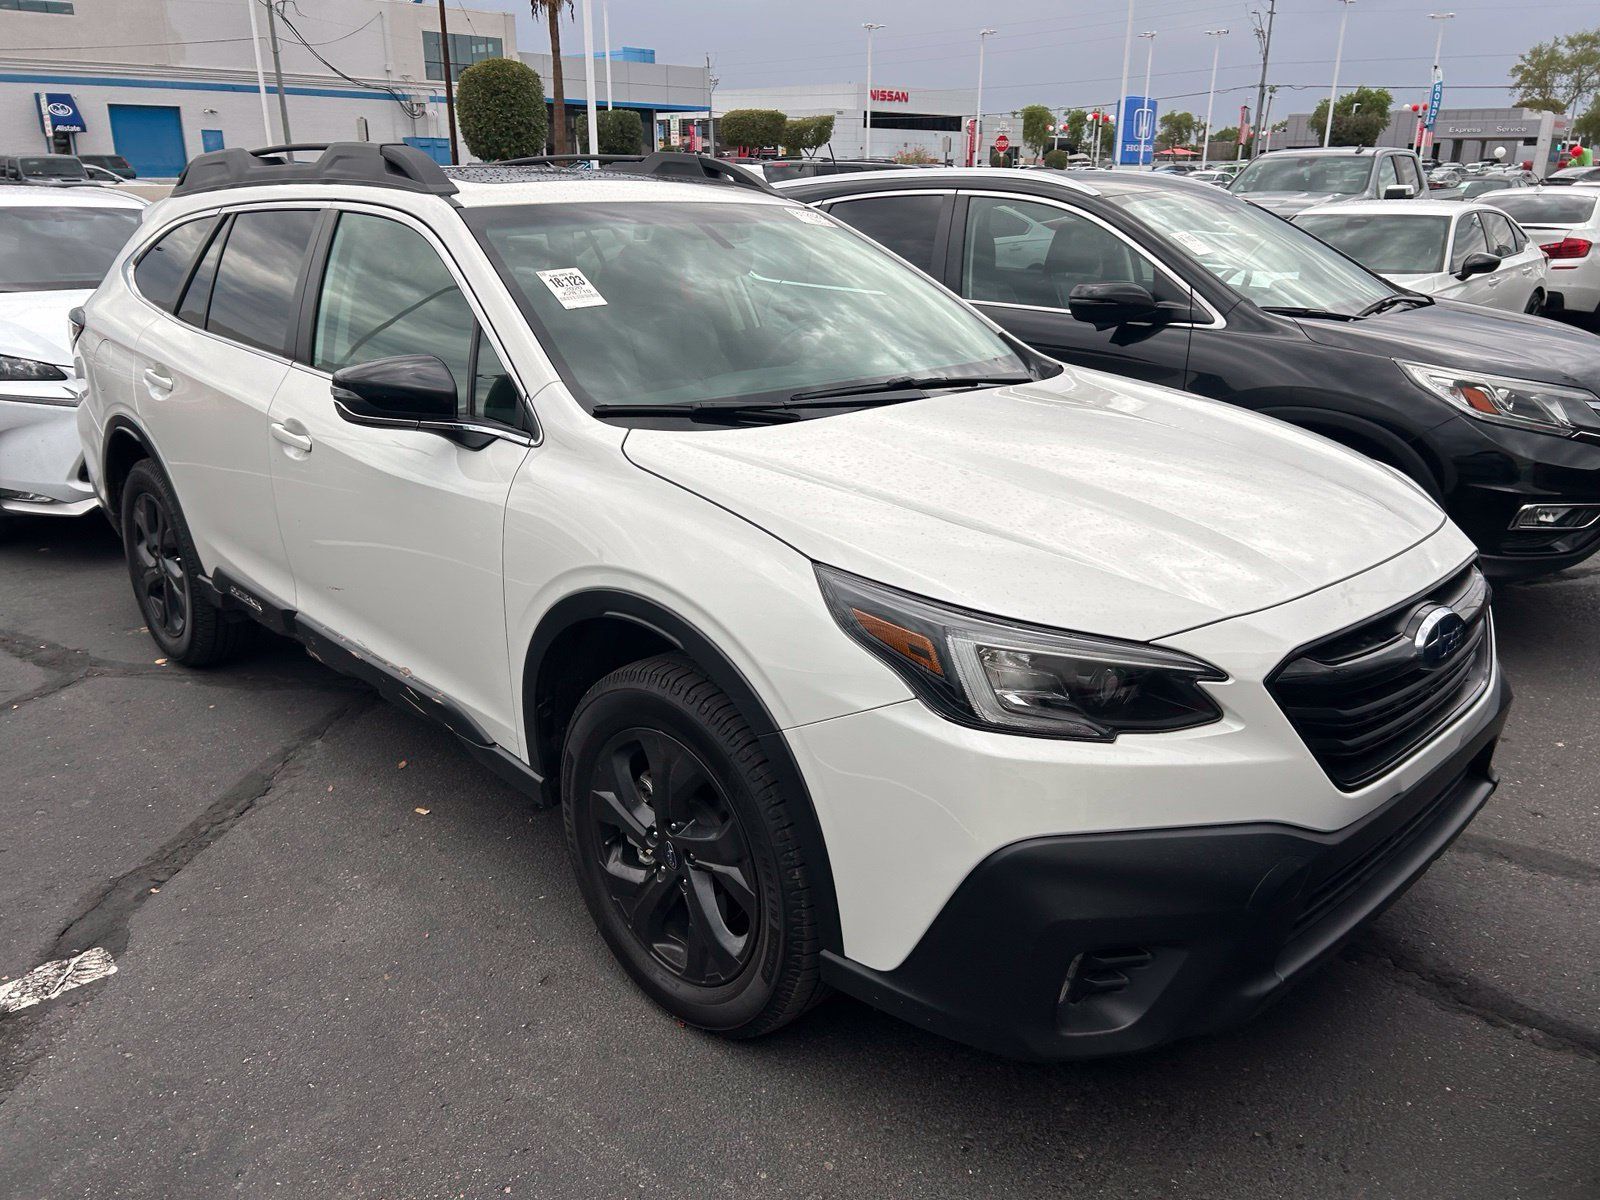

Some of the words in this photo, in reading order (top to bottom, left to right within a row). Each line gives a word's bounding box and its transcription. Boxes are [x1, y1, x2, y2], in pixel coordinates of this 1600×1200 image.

[870, 89, 909, 103] NISSAN
[55, 124, 81, 132] Allstate
[1496, 125, 1527, 133] Service
[995, 140, 1008, 148] STOP
[549, 275, 585, 288] 18:123
